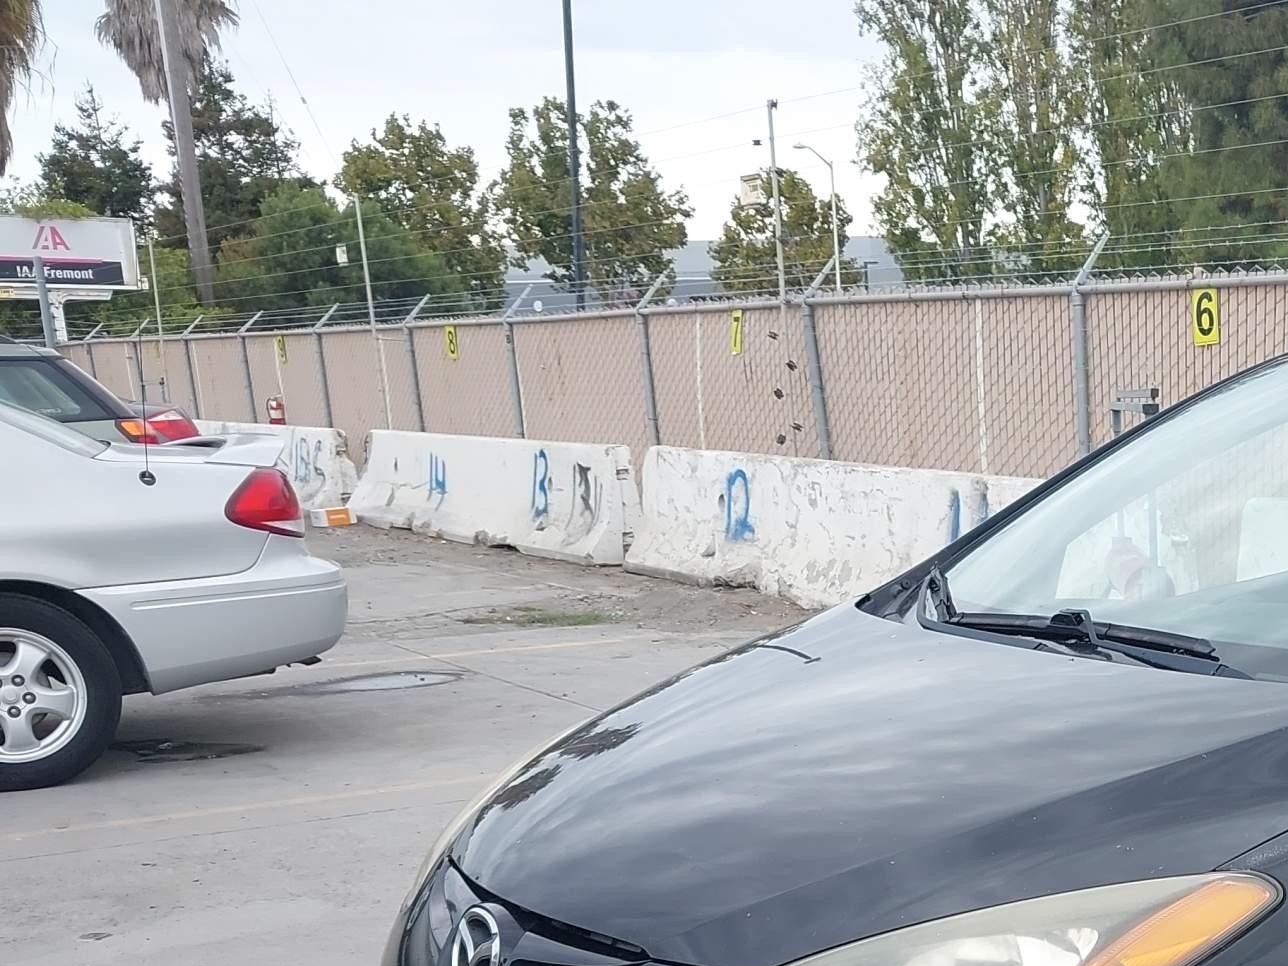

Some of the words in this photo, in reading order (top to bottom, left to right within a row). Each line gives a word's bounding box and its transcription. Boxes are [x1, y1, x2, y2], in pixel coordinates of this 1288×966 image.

[44, 267, 94, 280] Fremont
[1196, 292, 1214, 336] 6
[448, 330, 456, 354] 8
[733, 316, 740, 348] 7
